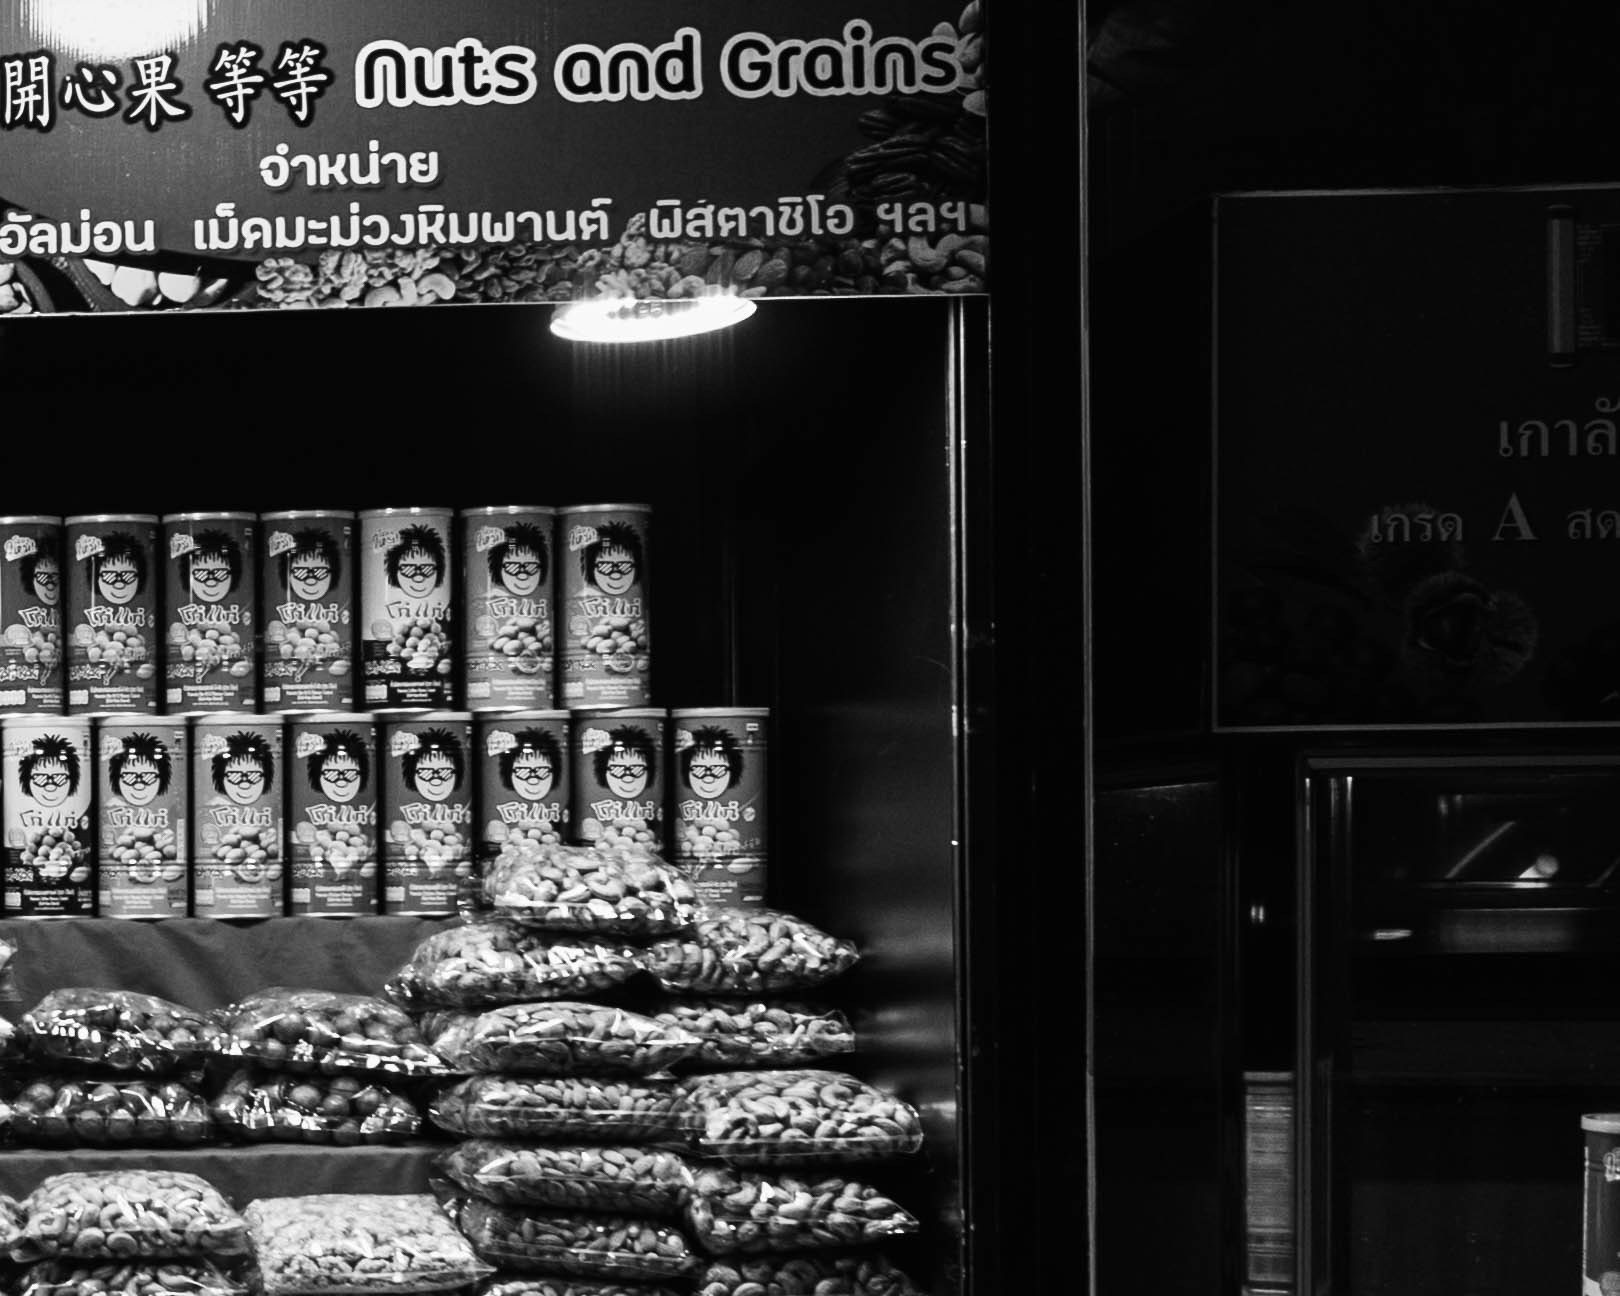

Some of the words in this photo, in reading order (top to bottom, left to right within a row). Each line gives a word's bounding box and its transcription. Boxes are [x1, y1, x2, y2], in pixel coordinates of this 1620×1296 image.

[4, 52, 187, 127] 開心果
[208, 37, 328, 124] 等等
[554, 26, 704, 101] and
[720, 18, 963, 98] Grains
[259, 139, 440, 188] จำหน่าย
[193, 197, 613, 252] เม็ดมะม่วงหิมพานต์
[648, 195, 855, 241] พิสตาชิโอ
[875, 200, 967, 238] ฯลฯ
[1490, 490, 1540, 542] A
